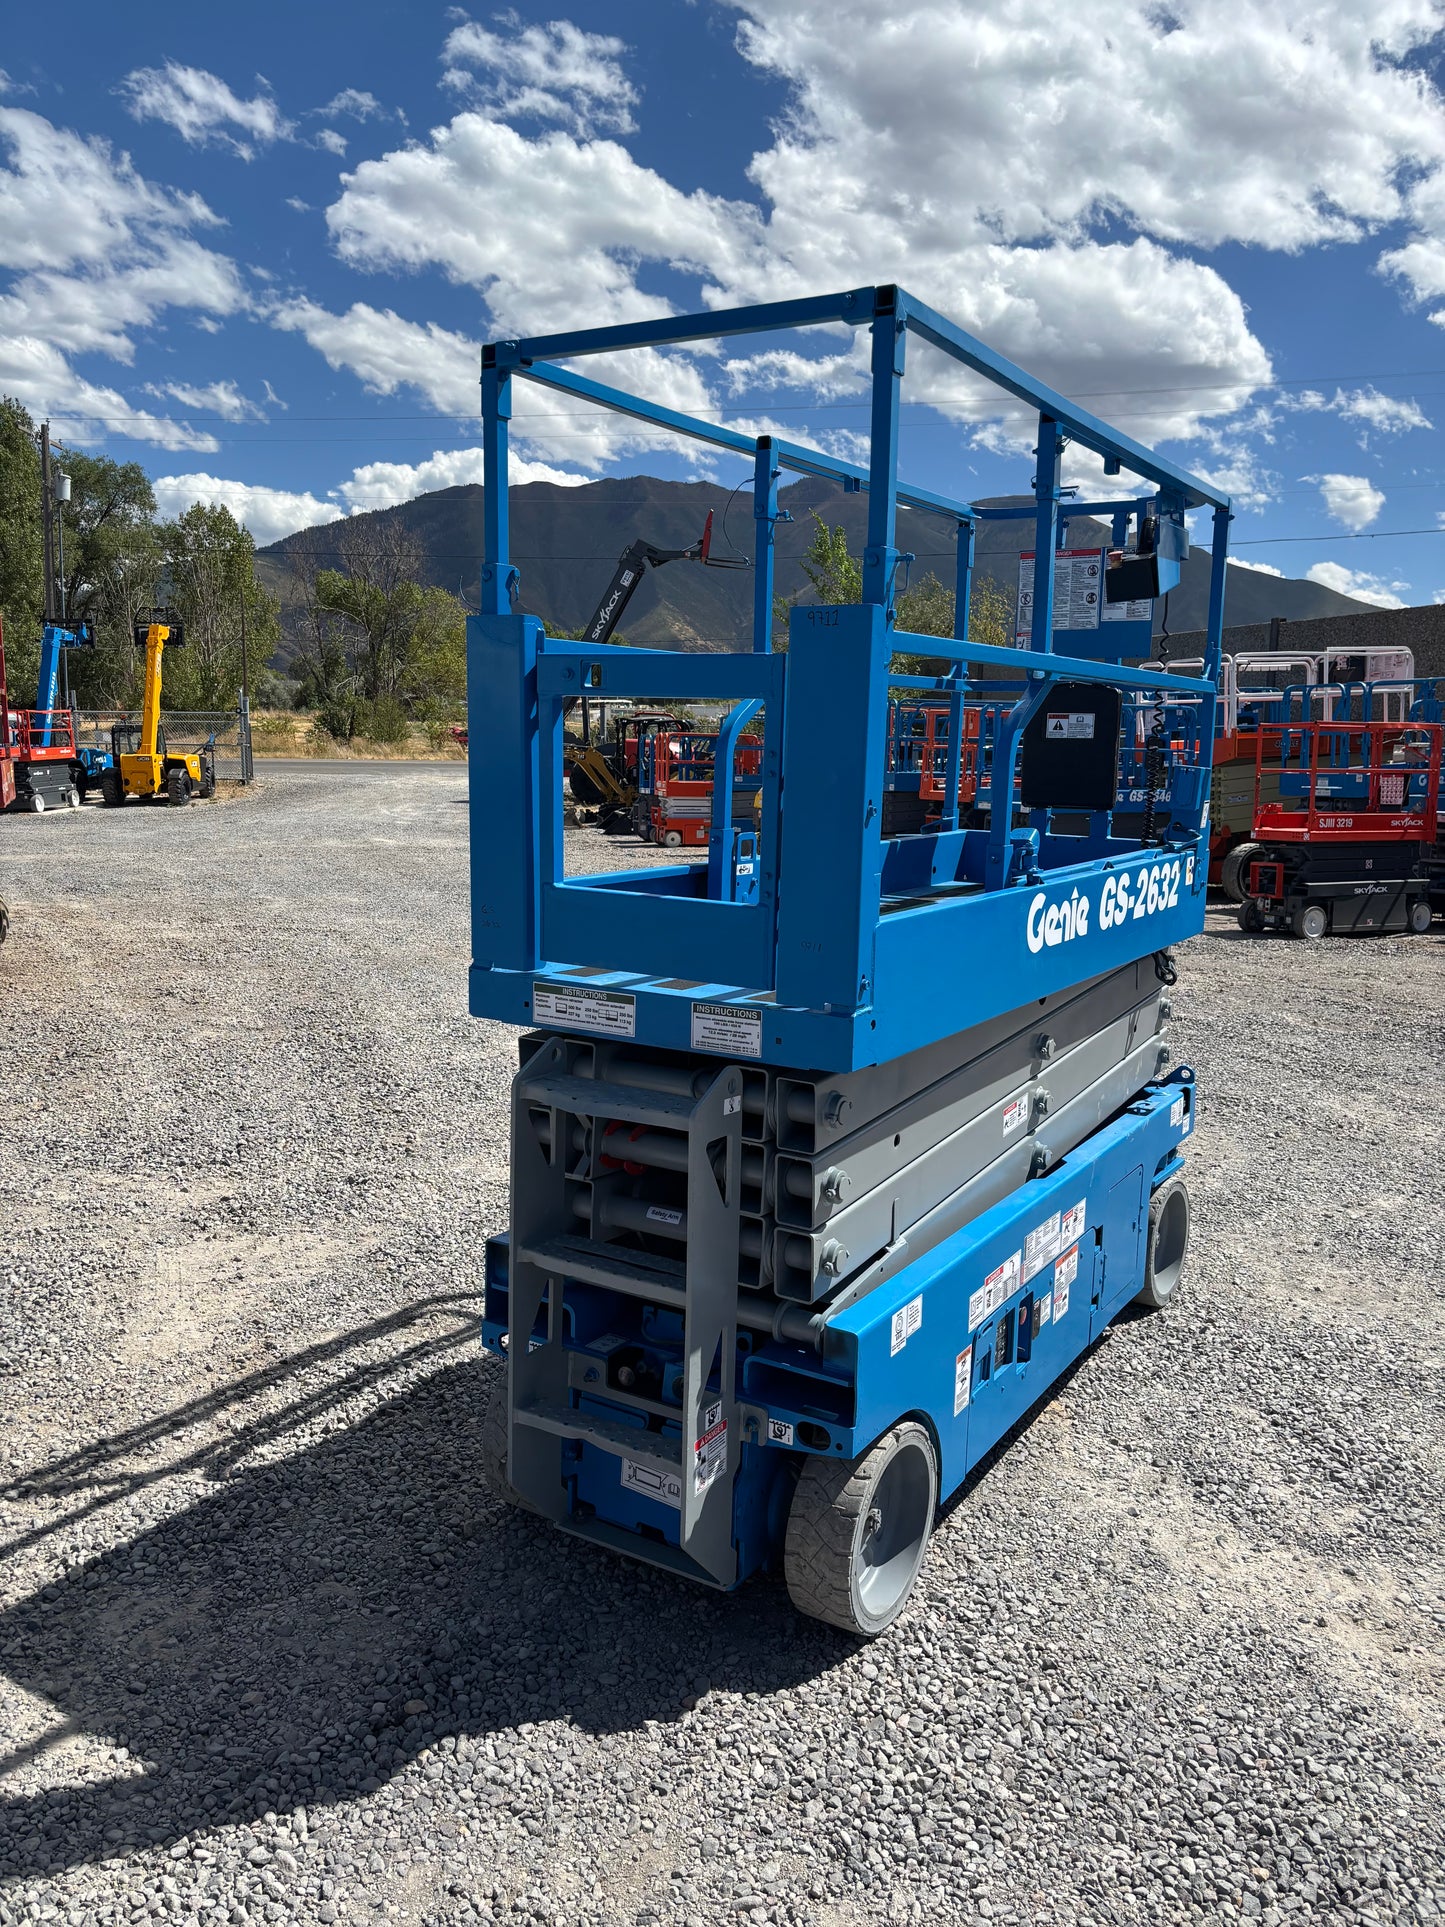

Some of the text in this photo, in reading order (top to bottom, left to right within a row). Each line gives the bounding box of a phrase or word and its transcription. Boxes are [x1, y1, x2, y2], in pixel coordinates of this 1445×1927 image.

[591, 590, 622, 640] SKYJACK
[1336, 818, 1353, 828] 3219
[1391, 817, 1424, 827] SKYJACK
[1354, 884, 1388, 894] SKYJACK
[1027, 860, 1181, 953] Genie GS-2632
[562, 987, 608, 1001] INSTRUCTIONS
[696, 1004, 758, 1020] INSTRUCTIONS
